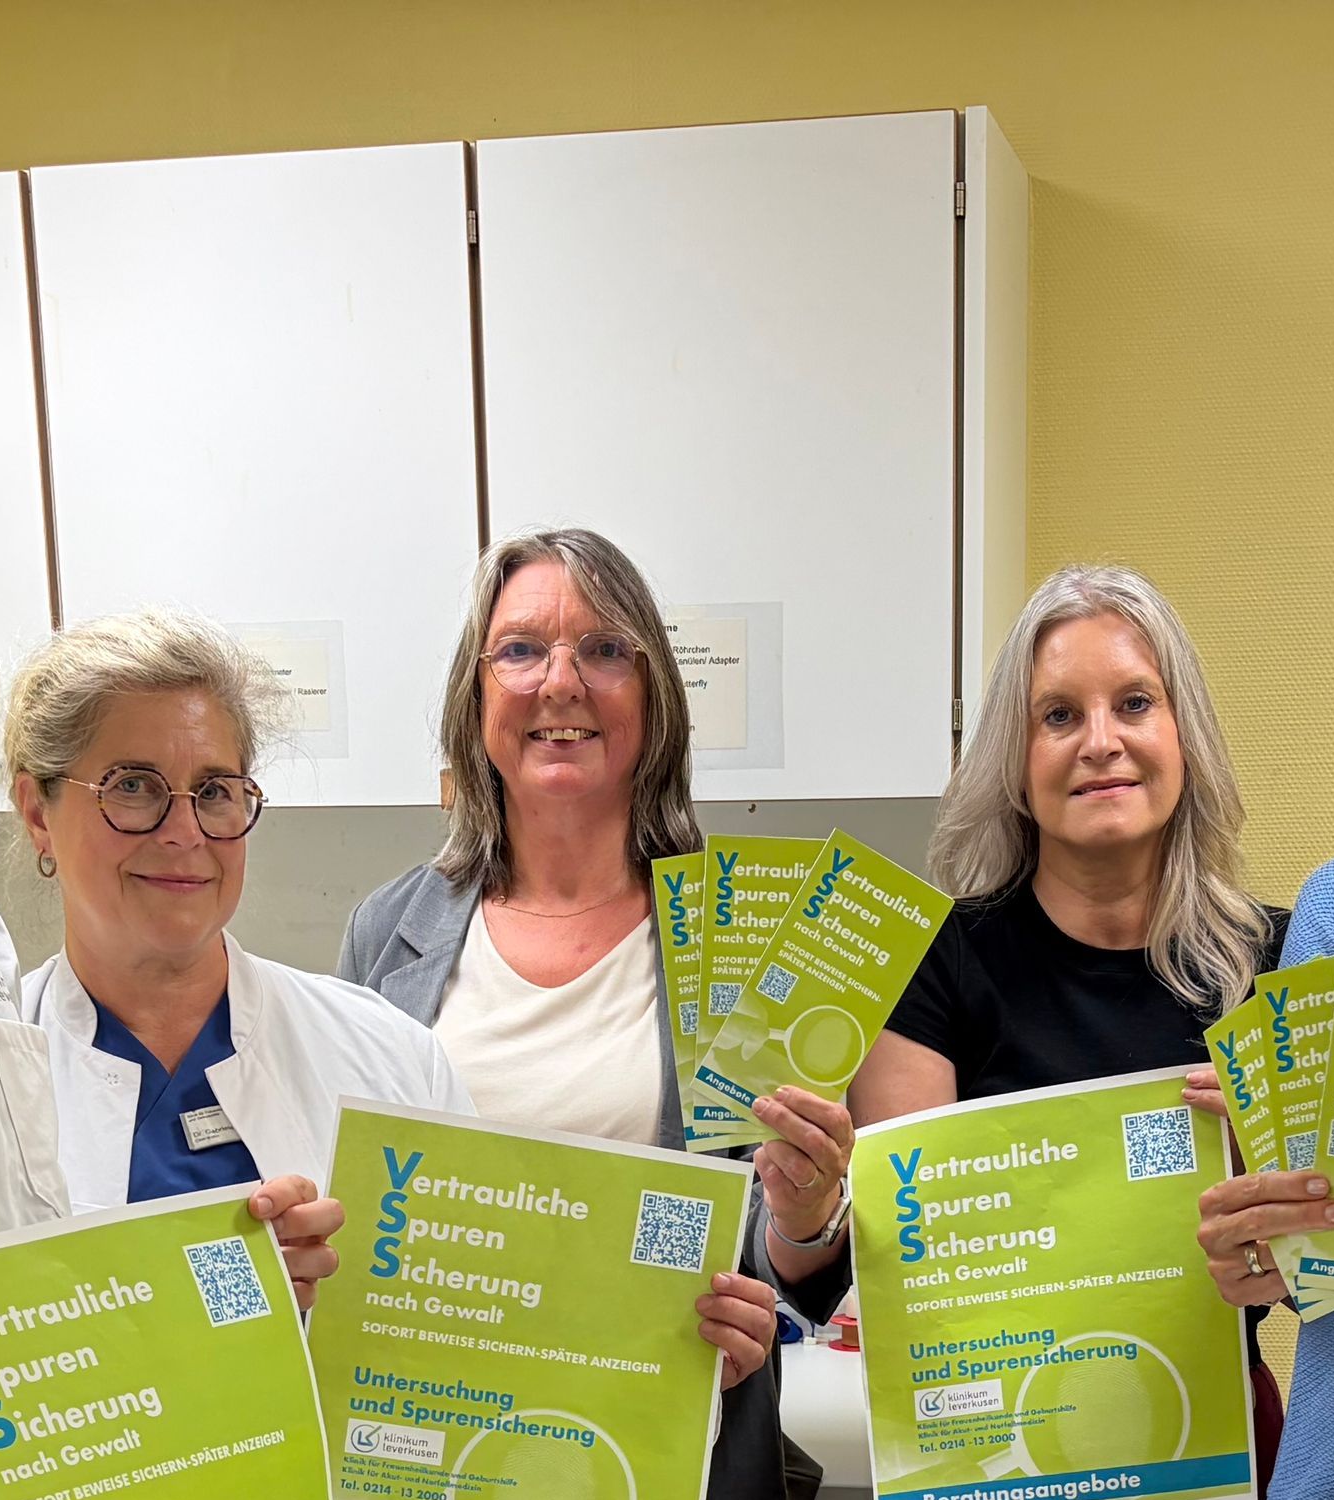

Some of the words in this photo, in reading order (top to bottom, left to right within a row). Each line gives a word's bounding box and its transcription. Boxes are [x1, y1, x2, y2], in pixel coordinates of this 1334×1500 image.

[709, 656, 739, 666] Adapter
[716, 876, 790, 903] Spuren
[816, 873, 881, 928] Spuren
[832, 848, 931, 930] Vertrauliche
[714, 934, 743, 944] nach
[793, 920, 822, 942] nach
[823, 937, 866, 968] Gewalt
[803, 896, 891, 966] Sicherung
[713, 956, 747, 964] SOFORT
[778, 949, 807, 973] SPÄTER
[805, 963, 846, 994] ANZEIGEN
[782, 940, 815, 965] SOFORT
[814, 958, 847, 983] BEWEISE
[705, 1073, 751, 1104] Angebote
[1279, 1073, 1312, 1092] nach
[889, 1138, 1078, 1185] Vertrauliche
[382, 1146, 589, 1221] Vertrauliche
[376, 1191, 505, 1249] Spuren
[895, 1185, 1011, 1225] Spuren
[898, 1225, 1056, 1263] Sicherung
[369, 1237, 543, 1308] Sicherung
[904, 1270, 950, 1289] nach
[955, 1256, 1028, 1281] Gewalt
[906, 1298, 954, 1314] SOFORT
[957, 1290, 1008, 1308] BEWEISE
[1011, 1274, 1113, 1300] SICHERN-SPÄTER
[1117, 1266, 1183, 1283] ANZEIGEN
[366, 1290, 418, 1312] nach
[424, 1297, 505, 1324] Gewalt
[362, 1321, 416, 1339] SOFORT
[419, 1329, 475, 1348] BEWEISE
[477, 1338, 587, 1366] SICHERN-SPÄTER
[590, 1356, 661, 1374] ANZEIGEN
[909, 1328, 1055, 1360] Untersuchung
[912, 1364, 951, 1383] und
[957, 1342, 1139, 1380] Spurensicherung
[354, 1367, 514, 1410] Untersuchung
[948, 1391, 987, 1401] klinikum
[949, 1398, 999, 1411] leverkusen
[350, 1397, 394, 1416] und
[400, 1400, 596, 1447] Spurensicherung
[384, 1433, 428, 1447] klinikum
[919, 1431, 938, 1439] Klinik
[1, 1454, 59, 1484] nach
[62, 1428, 142, 1469] Gewalt
[132, 1445, 231, 1486] SICHERN-SPÄTER
[232, 1430, 285, 1459] ANZEIGEN
[344, 1456, 365, 1466] Klinik
[383, 1443, 438, 1459] leverkusen
[919, 1444, 937, 1453] Tel.
[940, 1439, 965, 1450] 0214
[989, 1432, 1016, 1444] 2000
[341, 1479, 359, 1490] Tel.
[363, 1482, 391, 1495] 0214
[342, 1467, 364, 1476] Klinik
